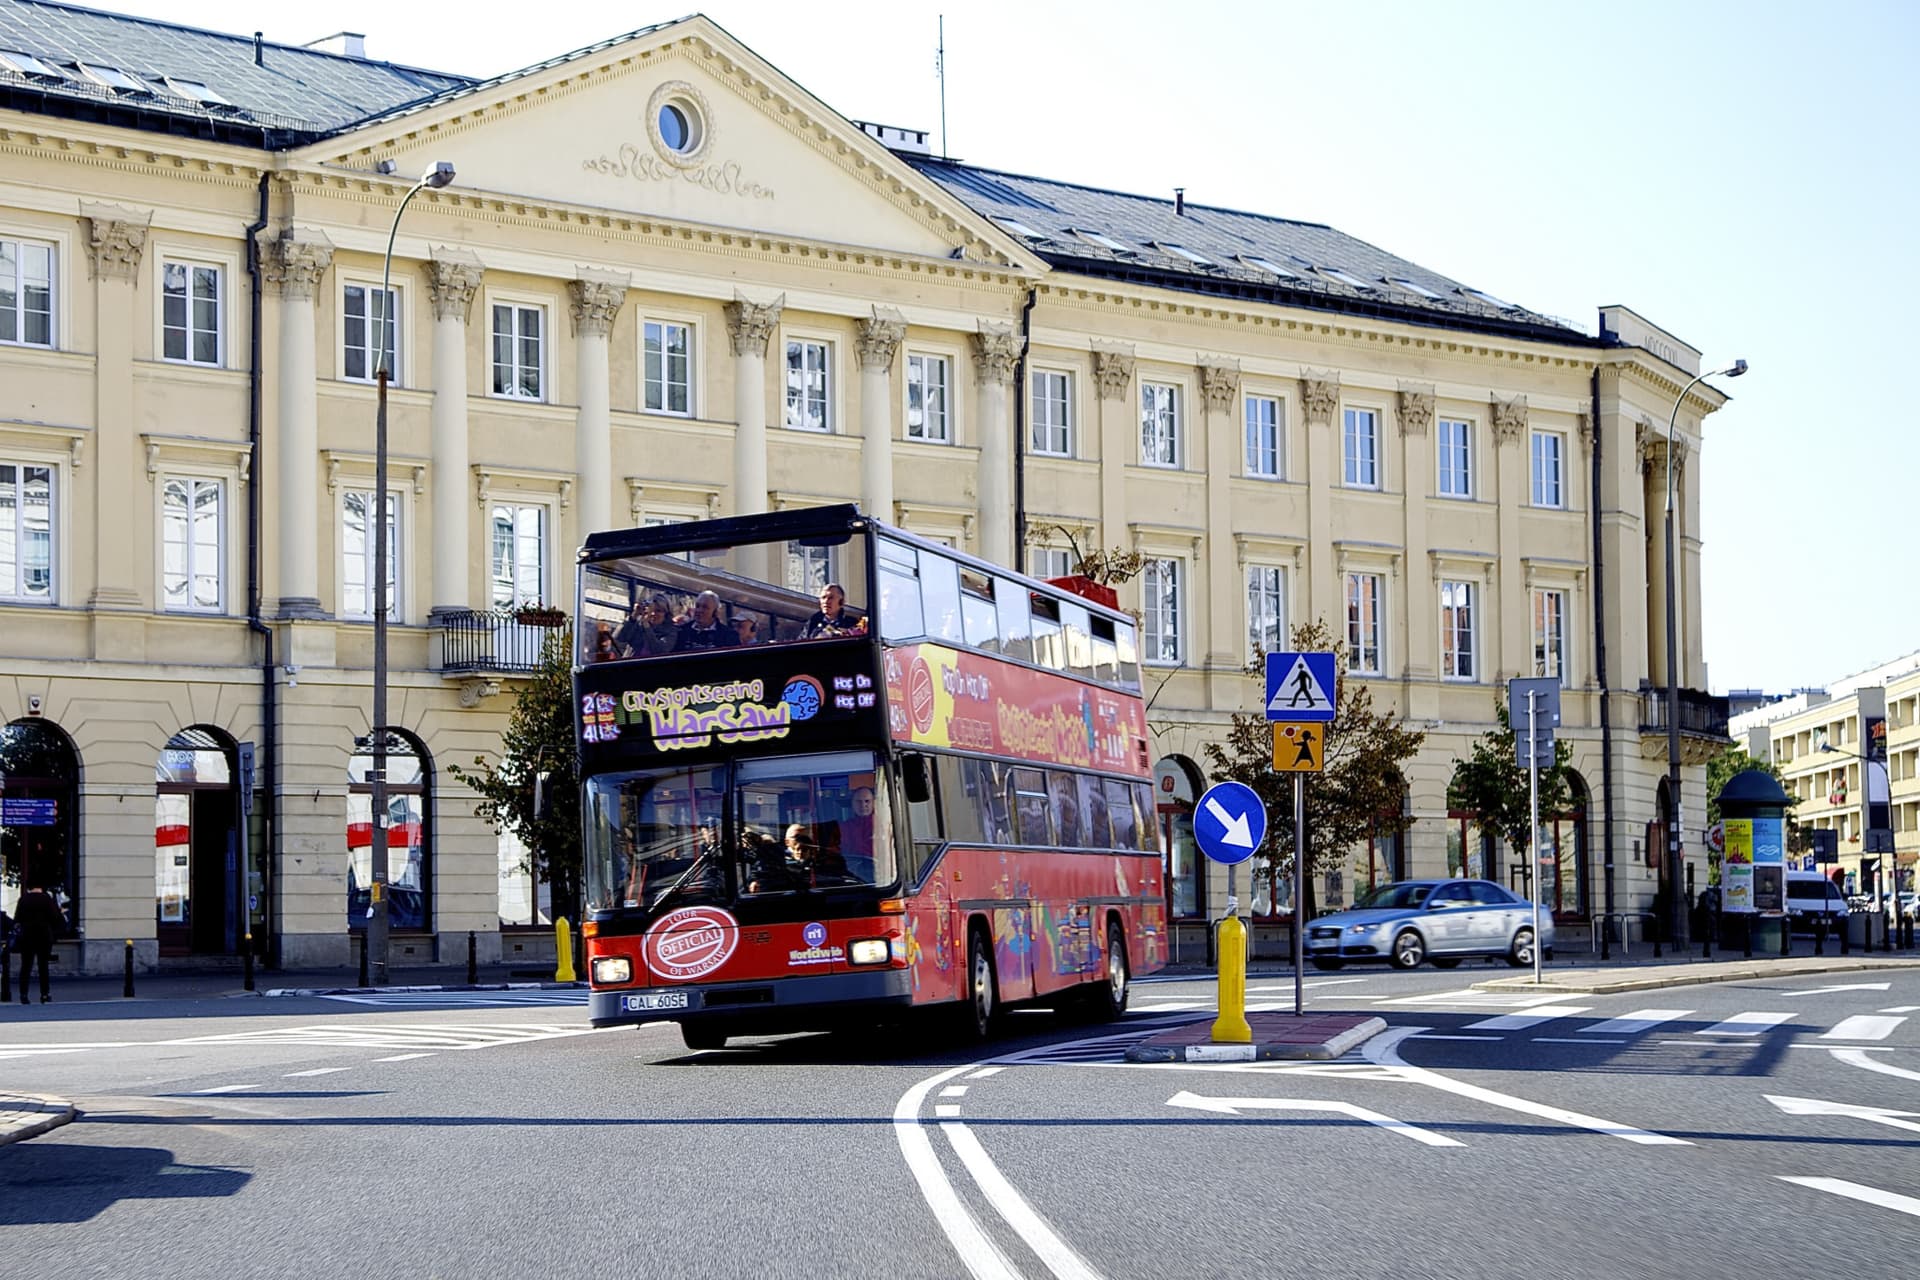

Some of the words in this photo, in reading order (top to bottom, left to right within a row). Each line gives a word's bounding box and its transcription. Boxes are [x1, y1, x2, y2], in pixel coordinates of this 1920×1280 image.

[856, 674, 871, 688] On
[858, 693, 875, 707] Off
[667, 910, 697, 925] TOUR
[661, 928, 721, 957] OFFICIAL
[669, 966, 684, 976] OF
[687, 947, 727, 975] WARSAW
[629, 996, 654, 1010] CAL
